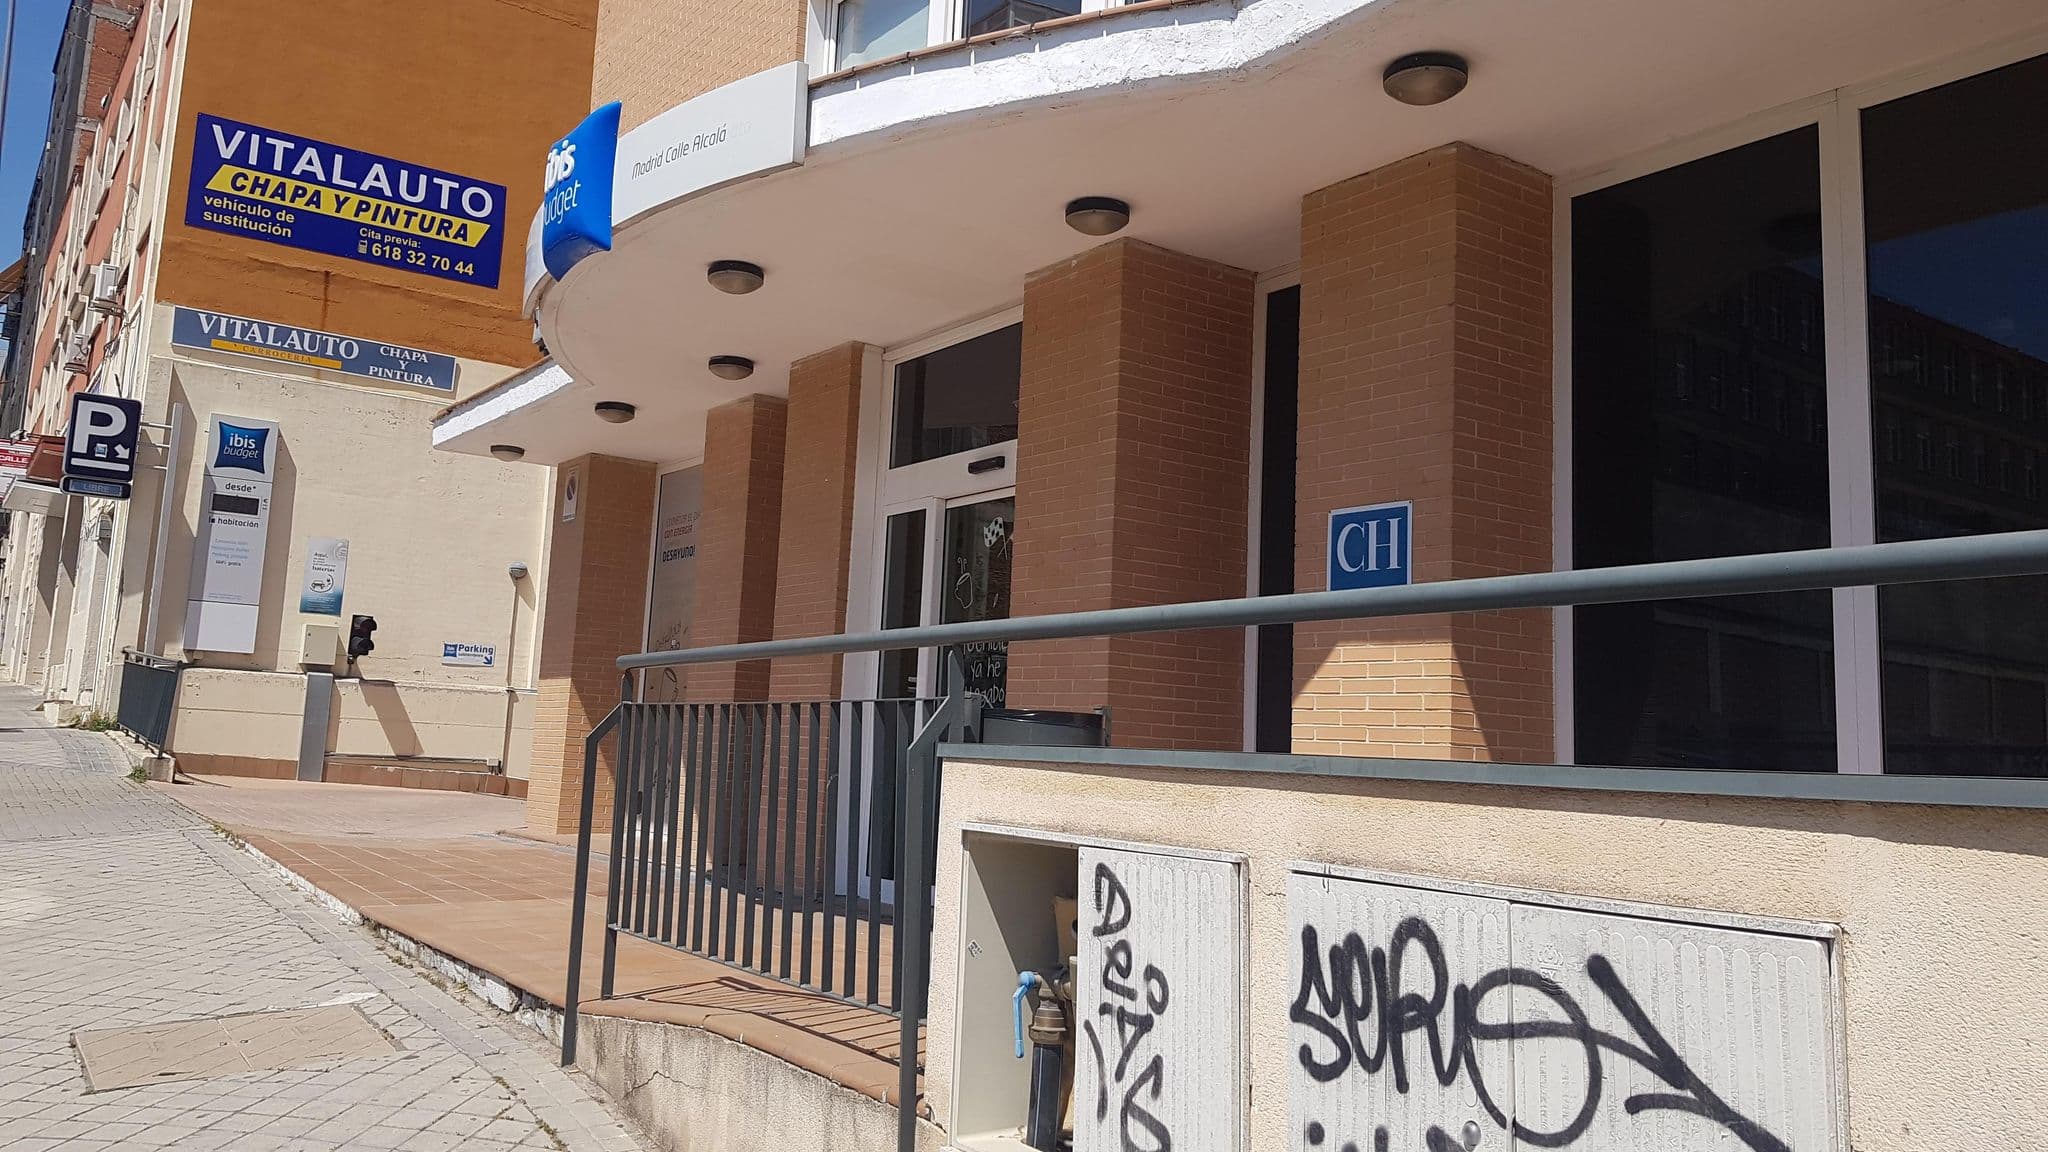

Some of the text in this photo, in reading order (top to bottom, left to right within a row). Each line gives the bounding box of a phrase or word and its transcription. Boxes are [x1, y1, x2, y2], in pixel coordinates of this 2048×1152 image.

[545, 140, 576, 193] ibis
[632, 150, 664, 180] Madrid
[665, 141, 690, 163] Calle
[692, 123, 727, 152] Alcalá
[212, 124, 493, 218] VITALAUTO
[204, 195, 295, 223] vehículo de
[230, 172, 469, 242] CHAPA Y PINTURA
[544, 180, 581, 225] udget
[203, 210, 292, 238] sustitución
[359, 227, 421, 248] Cita previa:
[372, 243, 474, 276] 618 32 70 44
[198, 313, 360, 360] VITALAUTO
[380, 346, 429, 363] CHAPA
[399, 360, 409, 370] Y
[369, 365, 435, 386] PINTURA
[72, 400, 127, 454] P
[229, 433, 256, 449] ibis
[223, 444, 260, 459] budget
[1337, 517, 1402, 573] CH
[458, 644, 494, 655] Parking
